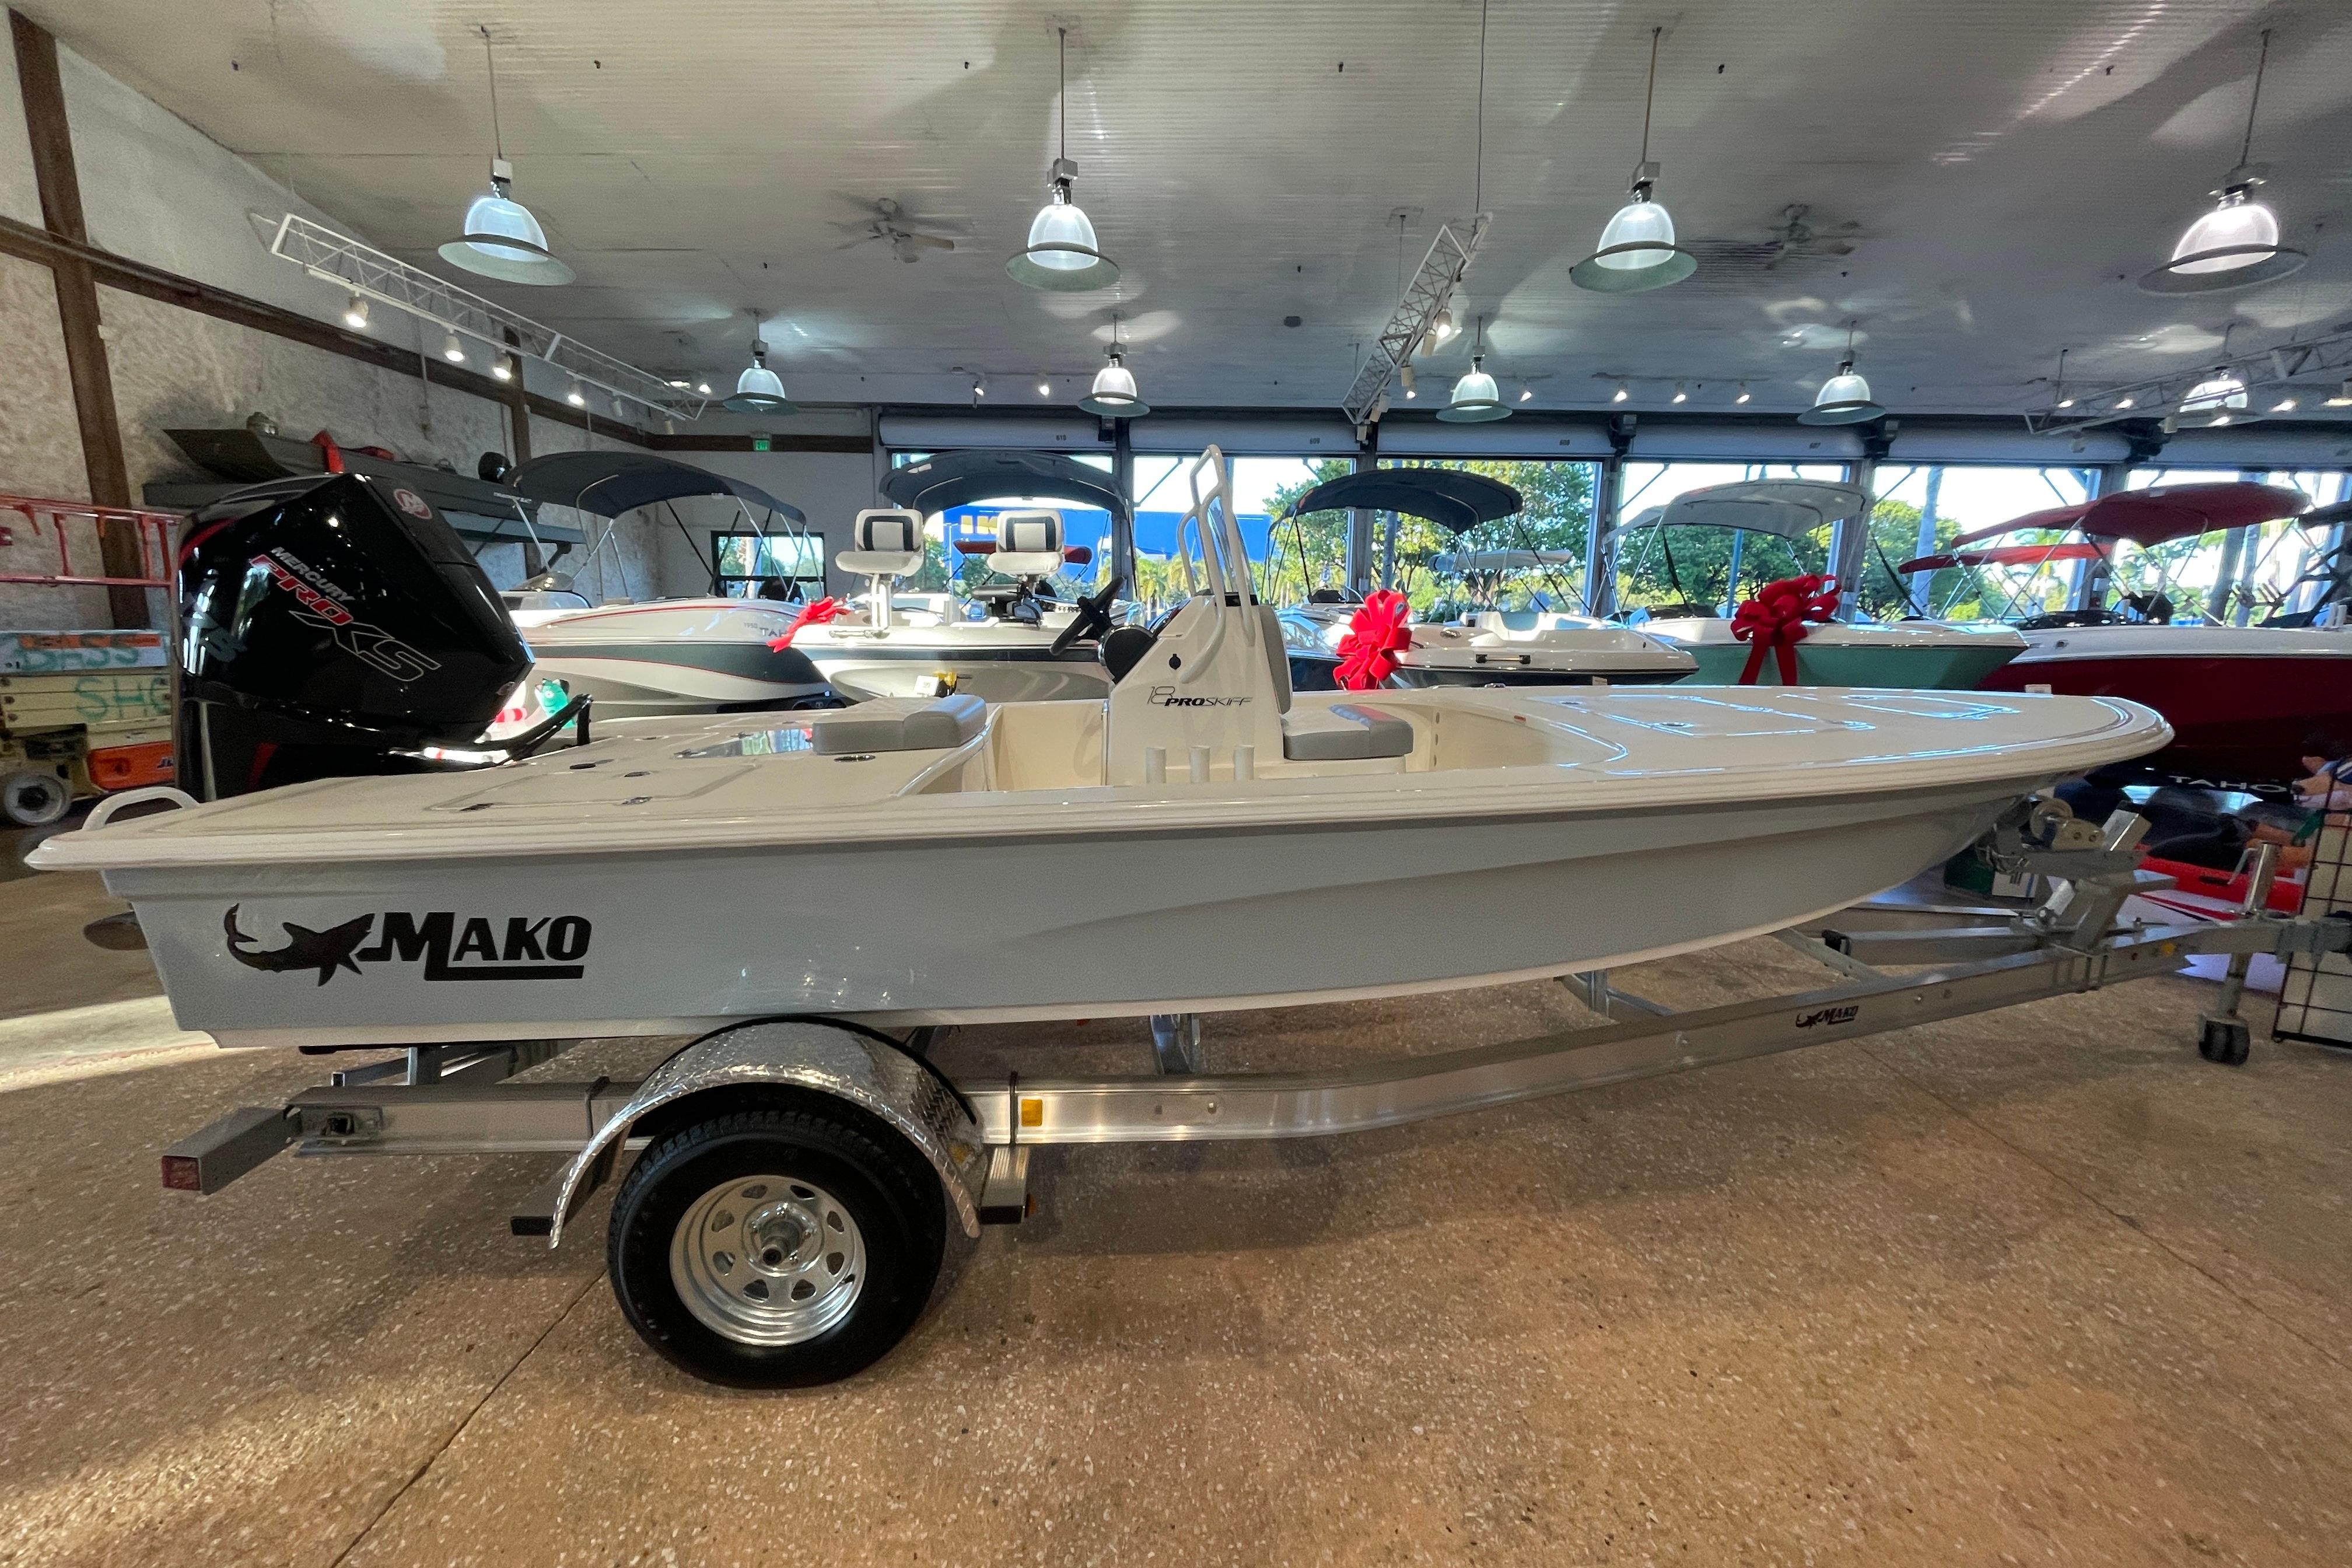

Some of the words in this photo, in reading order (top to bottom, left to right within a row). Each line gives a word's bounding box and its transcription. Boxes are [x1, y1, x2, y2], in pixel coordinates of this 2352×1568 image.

[961, 515, 998, 534] IK
[249, 554, 354, 626] PRO
[270, 547, 355, 601] MERCURY
[288, 610, 442, 682] XS
[1147, 686, 1176, 705] 18
[2168, 775, 2288, 793] TAHO
[355, 911, 592, 982] MAKO
[1819, 1005, 1859, 1026] MAKO
